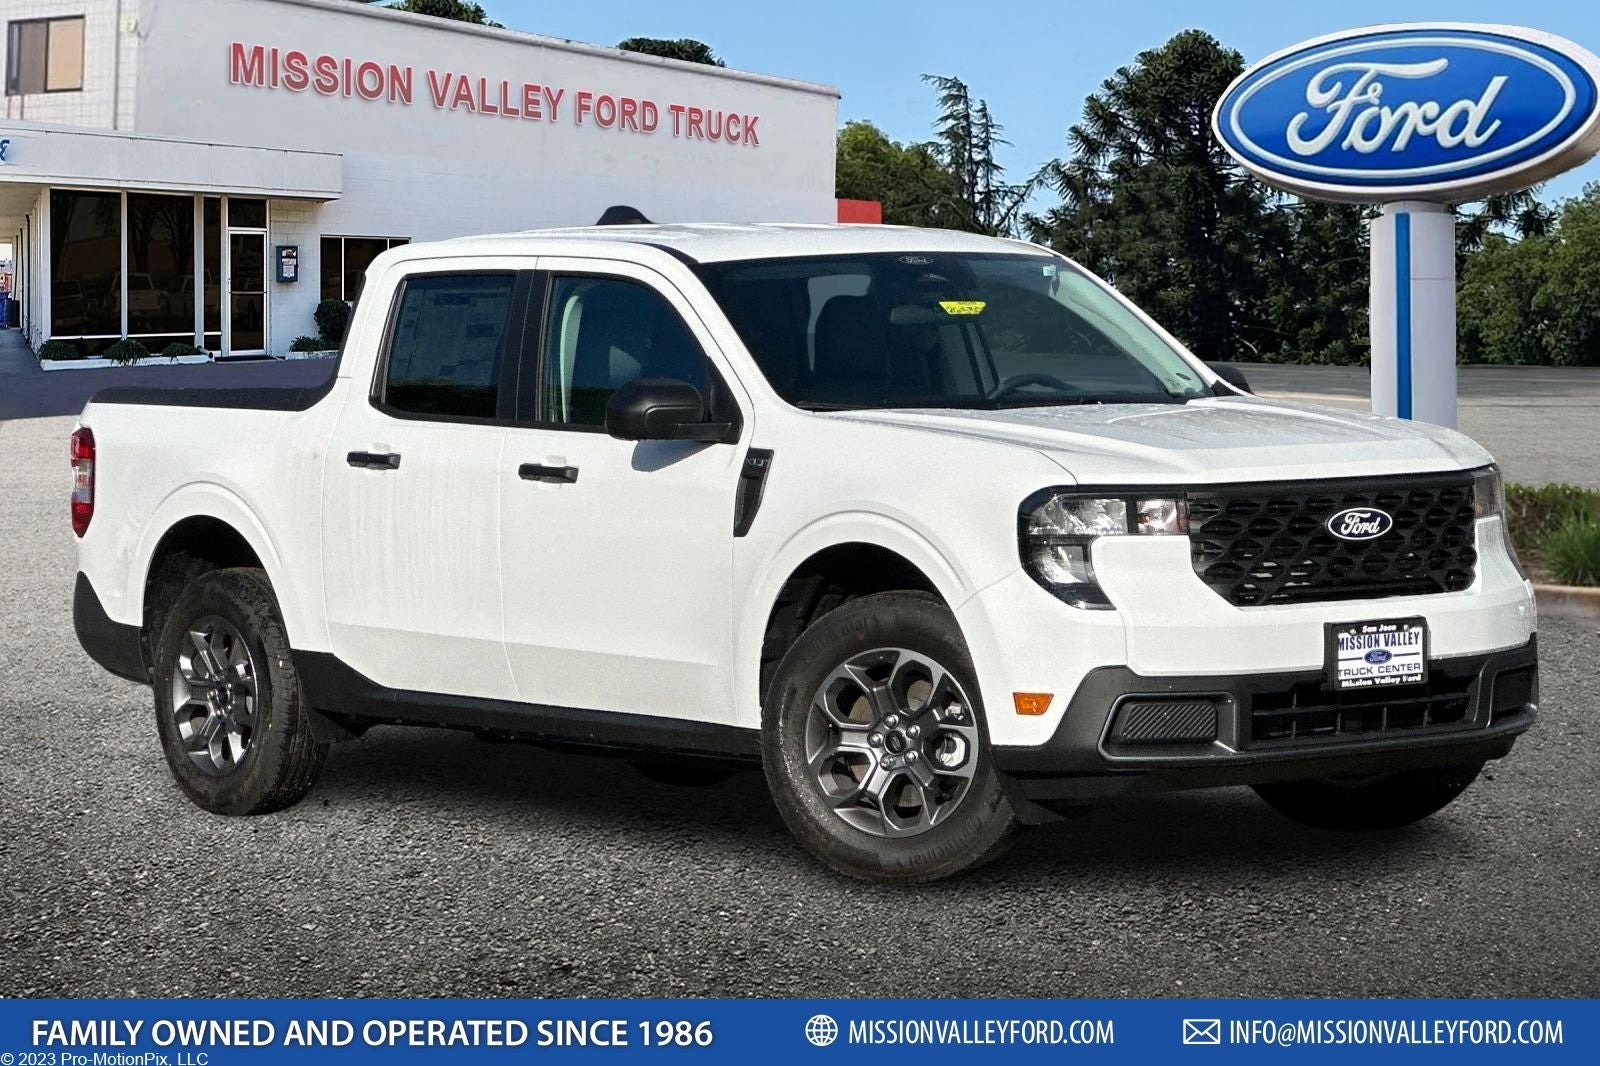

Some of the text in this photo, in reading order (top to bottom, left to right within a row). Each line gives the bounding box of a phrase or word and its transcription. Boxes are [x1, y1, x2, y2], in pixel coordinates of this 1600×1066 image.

[229, 42, 760, 145] MISSION VALLEY FORD TRUCK
[1286, 57, 1509, 157] Ford
[1340, 512, 1381, 535] Ford
[1362, 624, 1397, 633] San Jose
[1338, 631, 1420, 651] MISSION VALLEY
[1338, 662, 1421, 677] TRUCK CENTER
[1374, 675, 1401, 685] Valley
[1402, 672, 1421, 682] Ford
